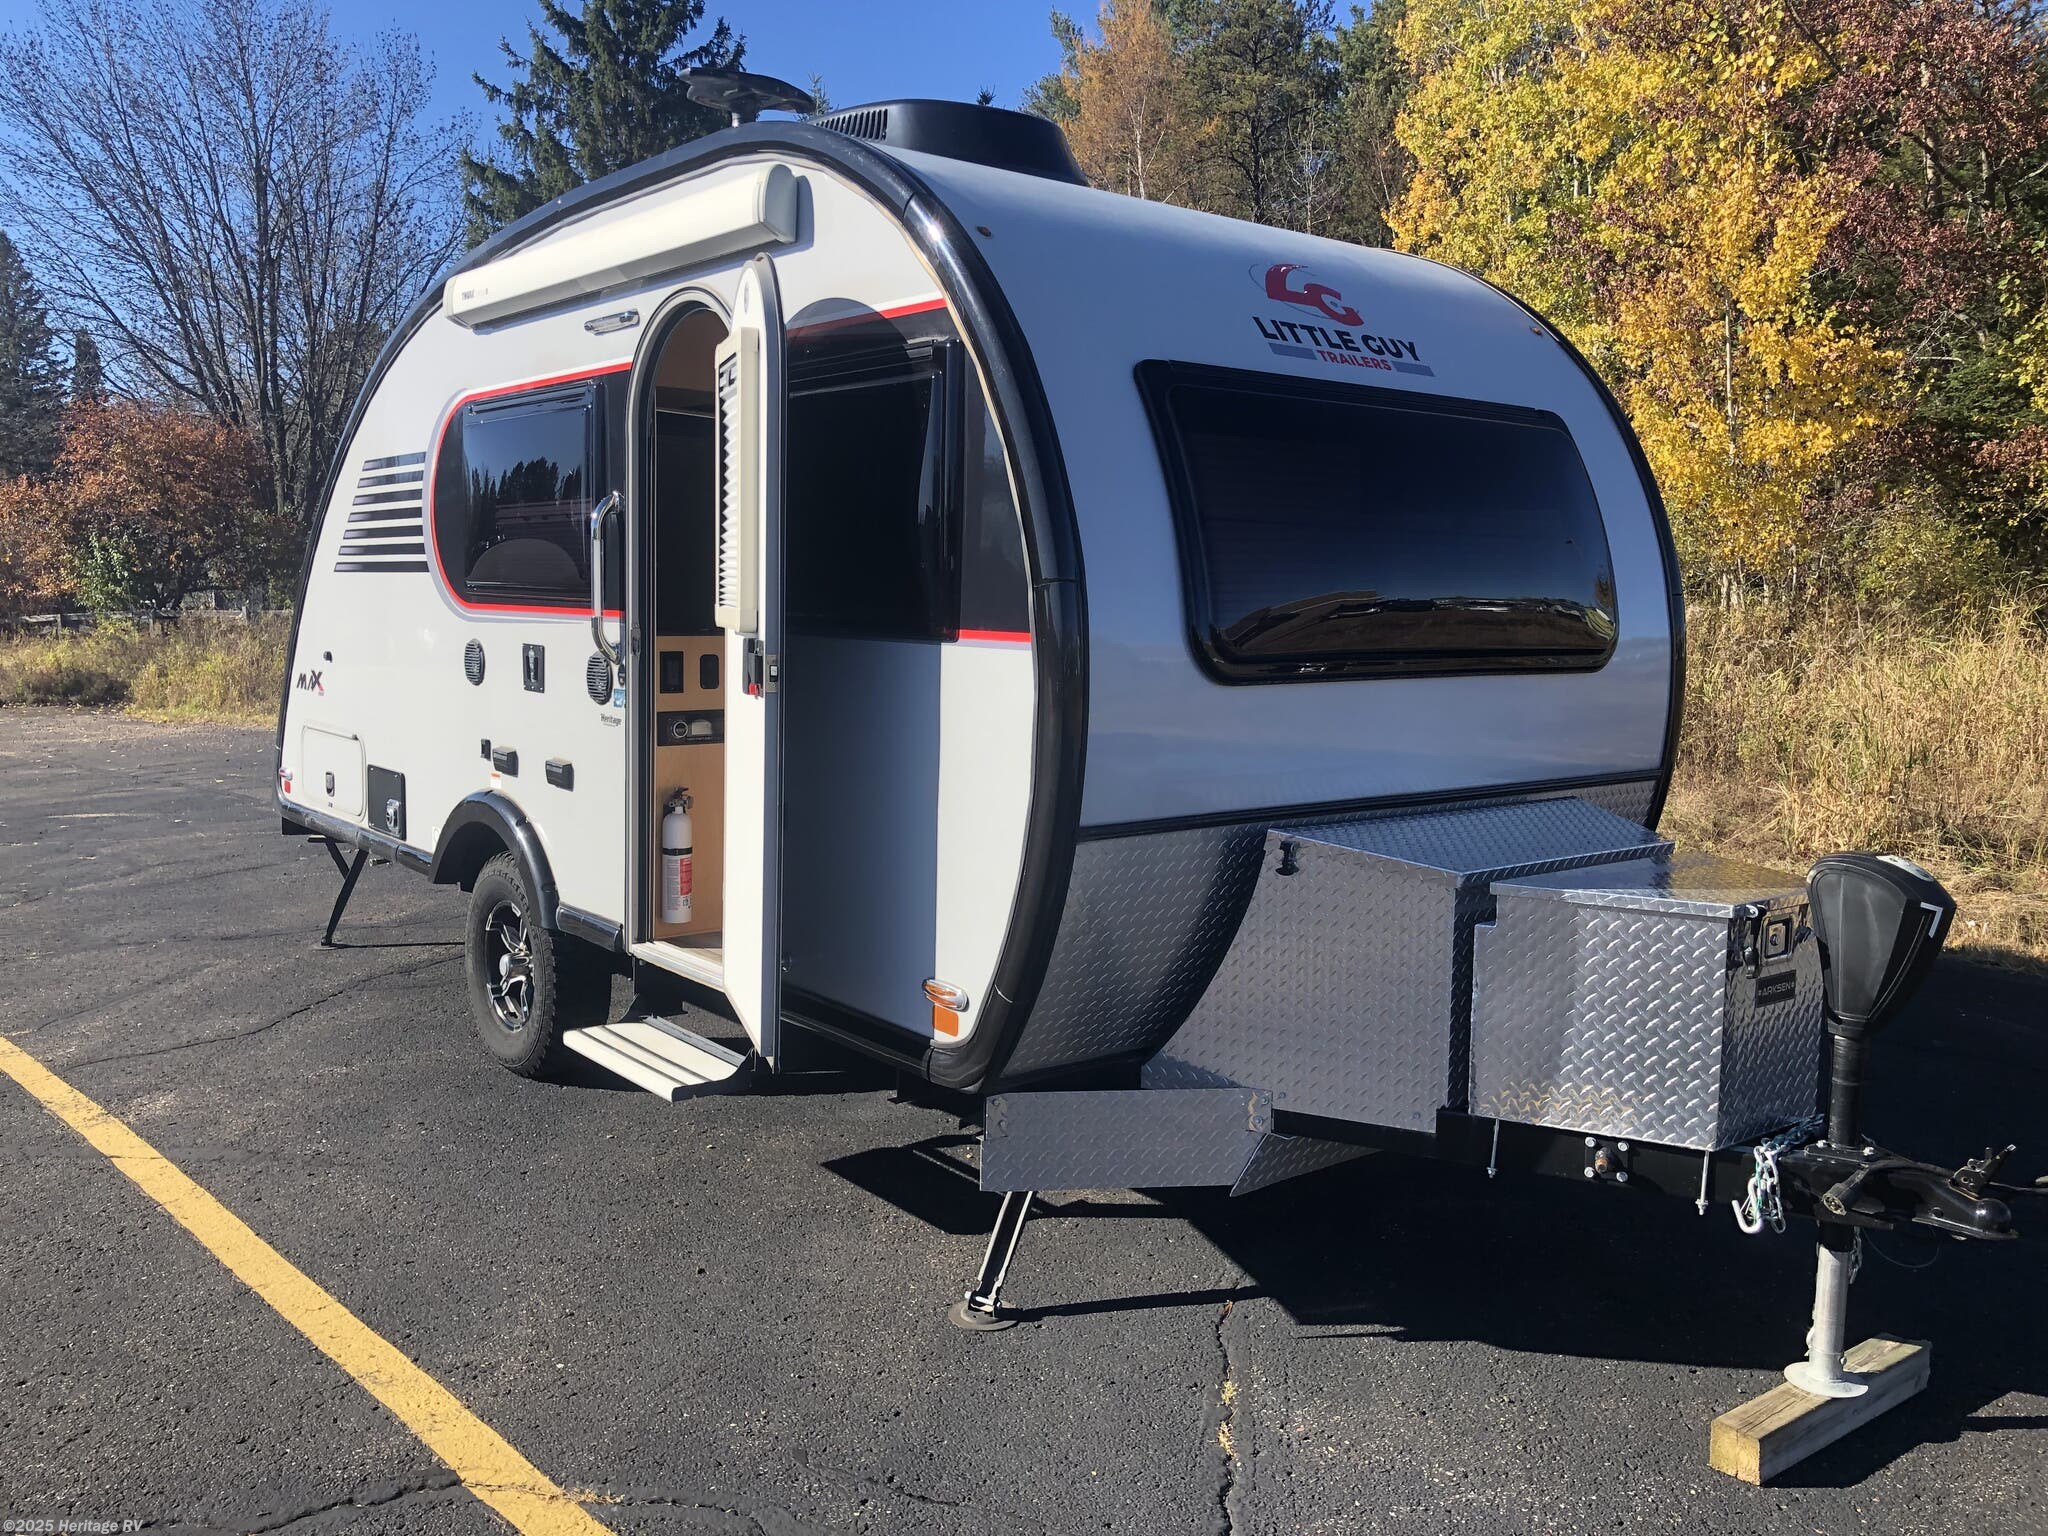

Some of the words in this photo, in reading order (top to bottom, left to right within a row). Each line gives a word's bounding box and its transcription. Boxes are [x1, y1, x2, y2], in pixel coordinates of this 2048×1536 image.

[1252, 316, 1362, 353] LITTLE
[1361, 334, 1420, 361] GUY
[1317, 350, 1392, 371] TRAILERS
[297, 670, 324, 691] MAX
